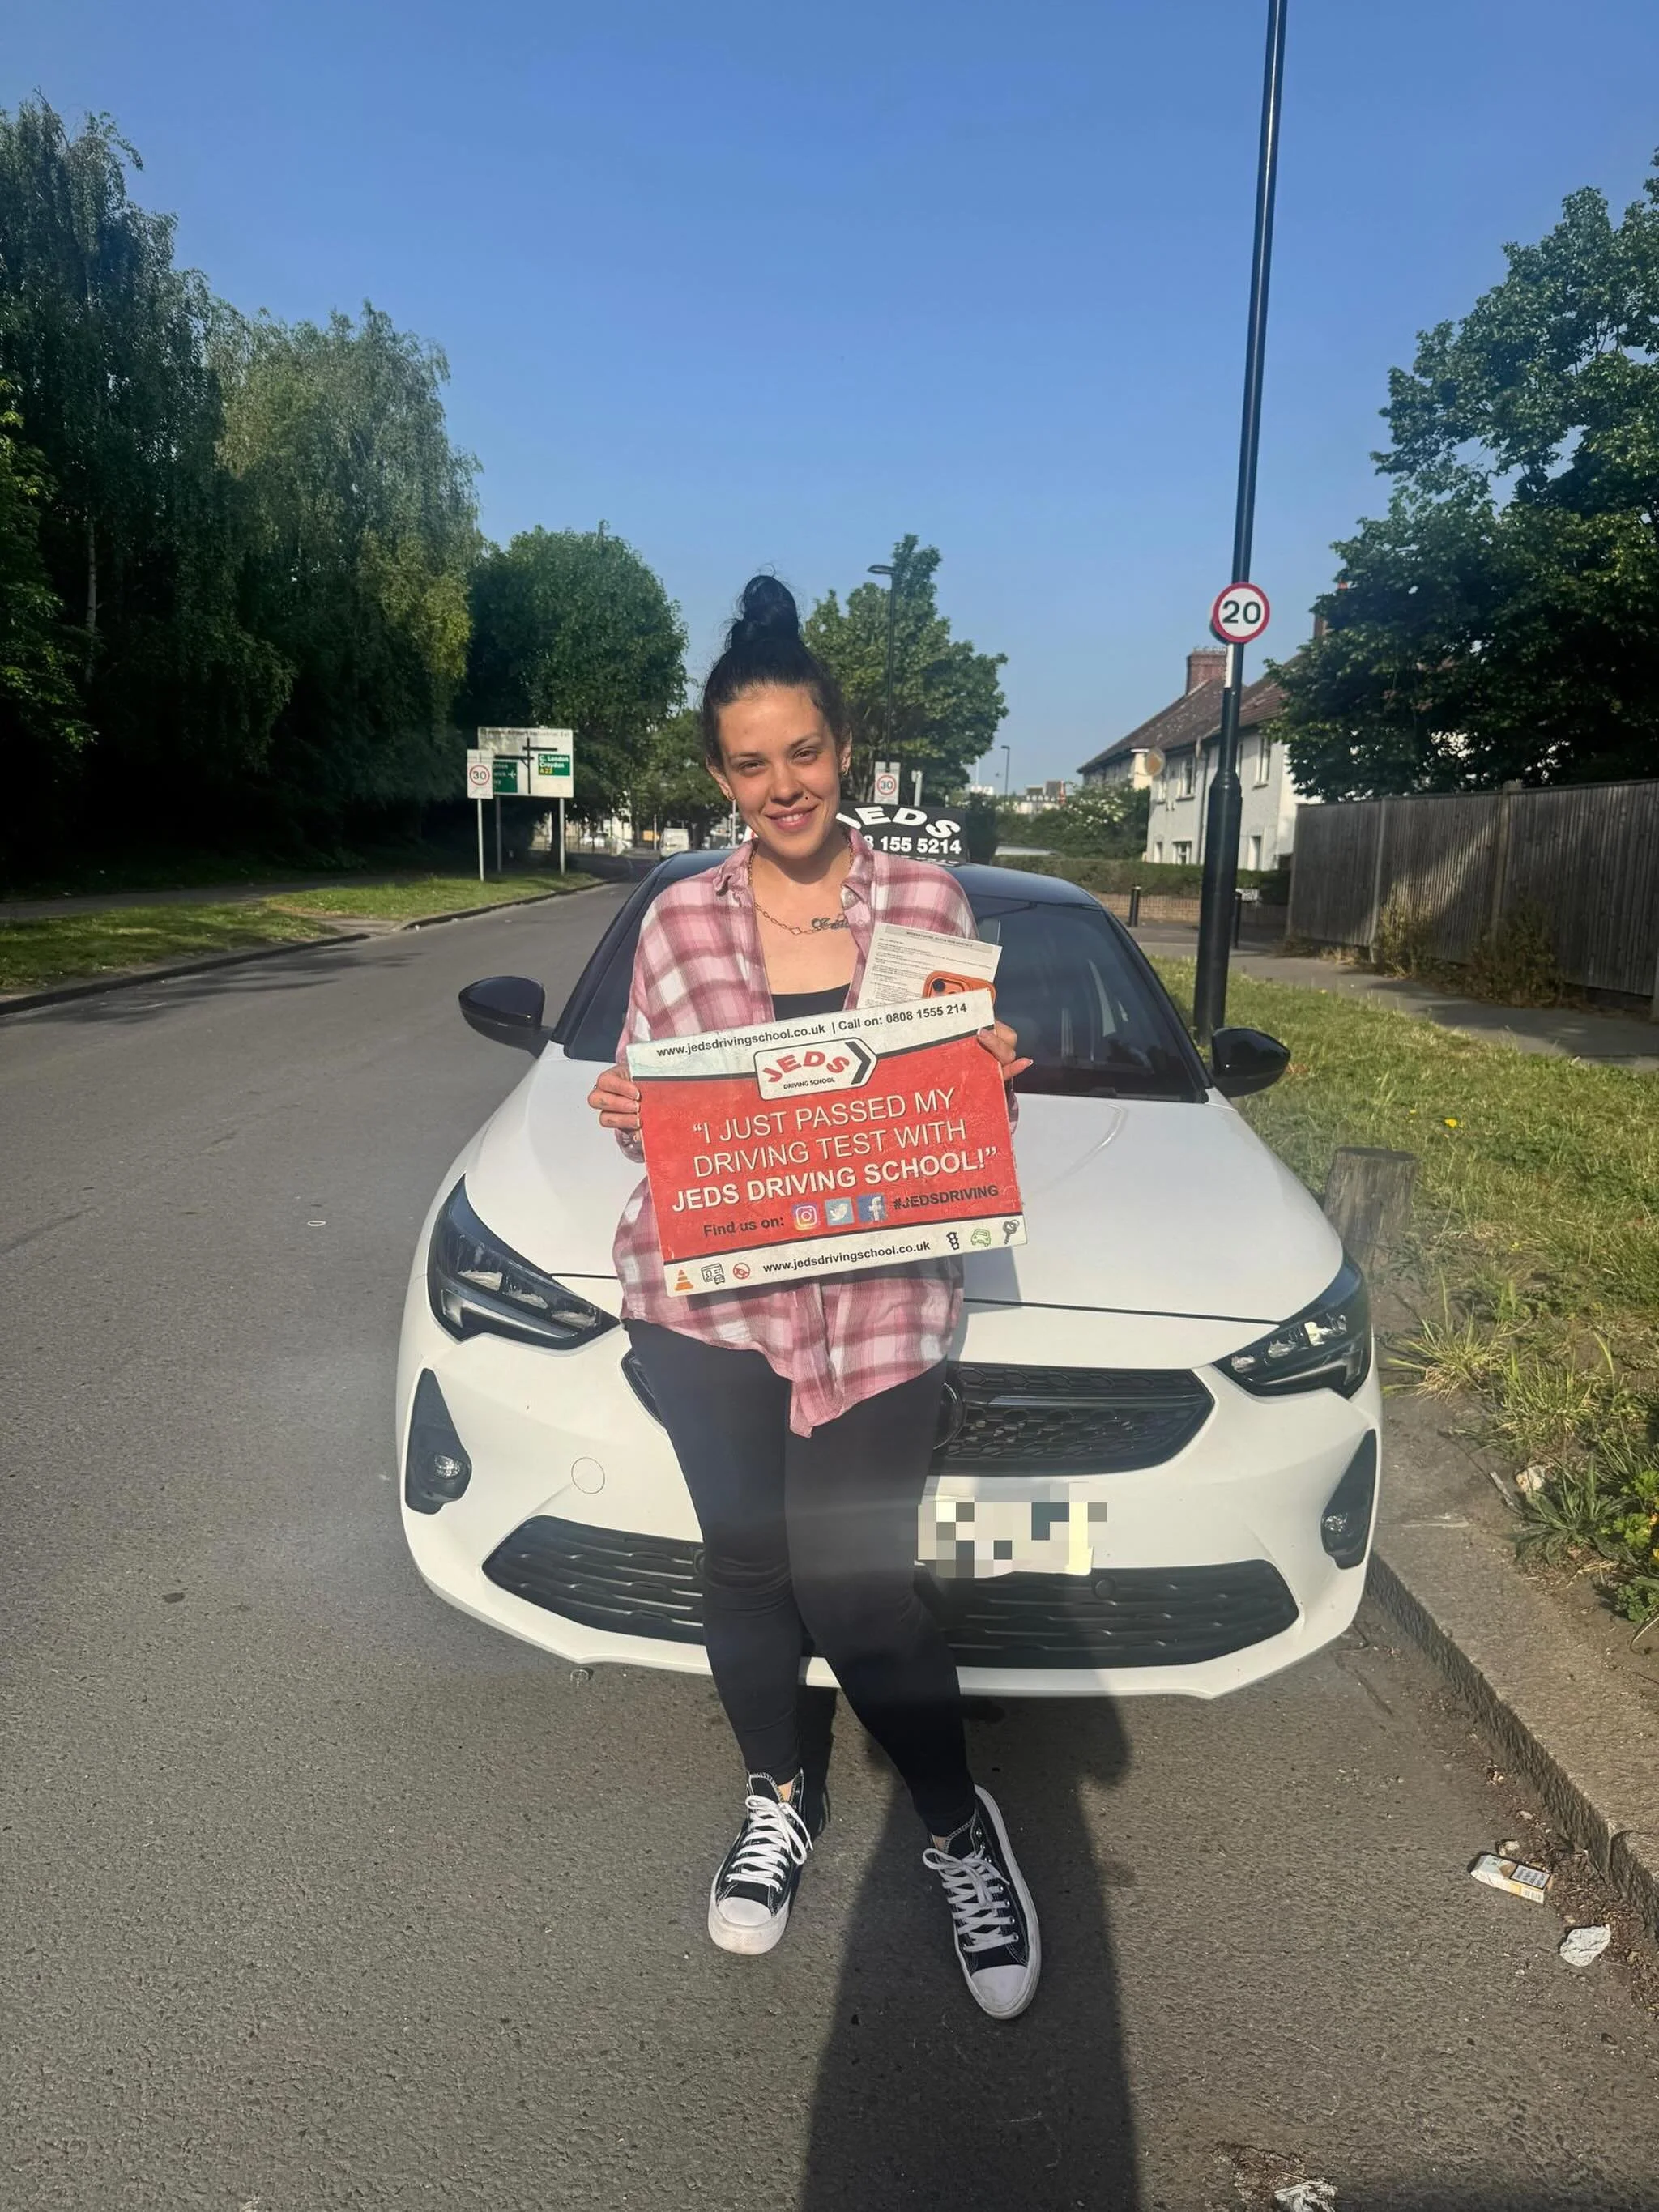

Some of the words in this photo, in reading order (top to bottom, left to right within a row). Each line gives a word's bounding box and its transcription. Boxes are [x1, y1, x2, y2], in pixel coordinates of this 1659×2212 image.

[1222, 600, 1261, 624] 20
[472, 770, 487, 780] 30
[880, 780, 893, 790] 30
[881, 836, 912, 852] 155
[916, 838, 962, 855] 5214
[656, 1024, 825, 1056] www.jedsdrivingschool.co.uk
[838, 1018, 860, 1030] Call
[864, 1016, 883, 1026] on:
[886, 1011, 913, 1024] 0808
[916, 1006, 944, 1019] 1555
[947, 1003, 967, 1014] 214
[762, 1051, 850, 1083] JEDS
[783, 1078, 808, 1089] DRIVING
[810, 1077, 835, 1086] SCHOOL
[719, 1111, 787, 1141] JUST
[795, 1095, 906, 1131] PASSED
[914, 1087, 955, 1114] MY
[693, 1141, 809, 1178] DRIVING
[816, 1130, 887, 1160] TEST
[894, 1119, 966, 1149] WITH
[672, 1183, 740, 1212] JEDS
[747, 1166, 856, 1201] DRIVING
[893, 1185, 999, 1210] #JEDSDRIVING
[703, 1221, 736, 1238] Find
[740, 1220, 757, 1232] us
[761, 1217, 785, 1229] on:
[763, 1241, 931, 1272] www.jedsdrivingschool.co.uk
